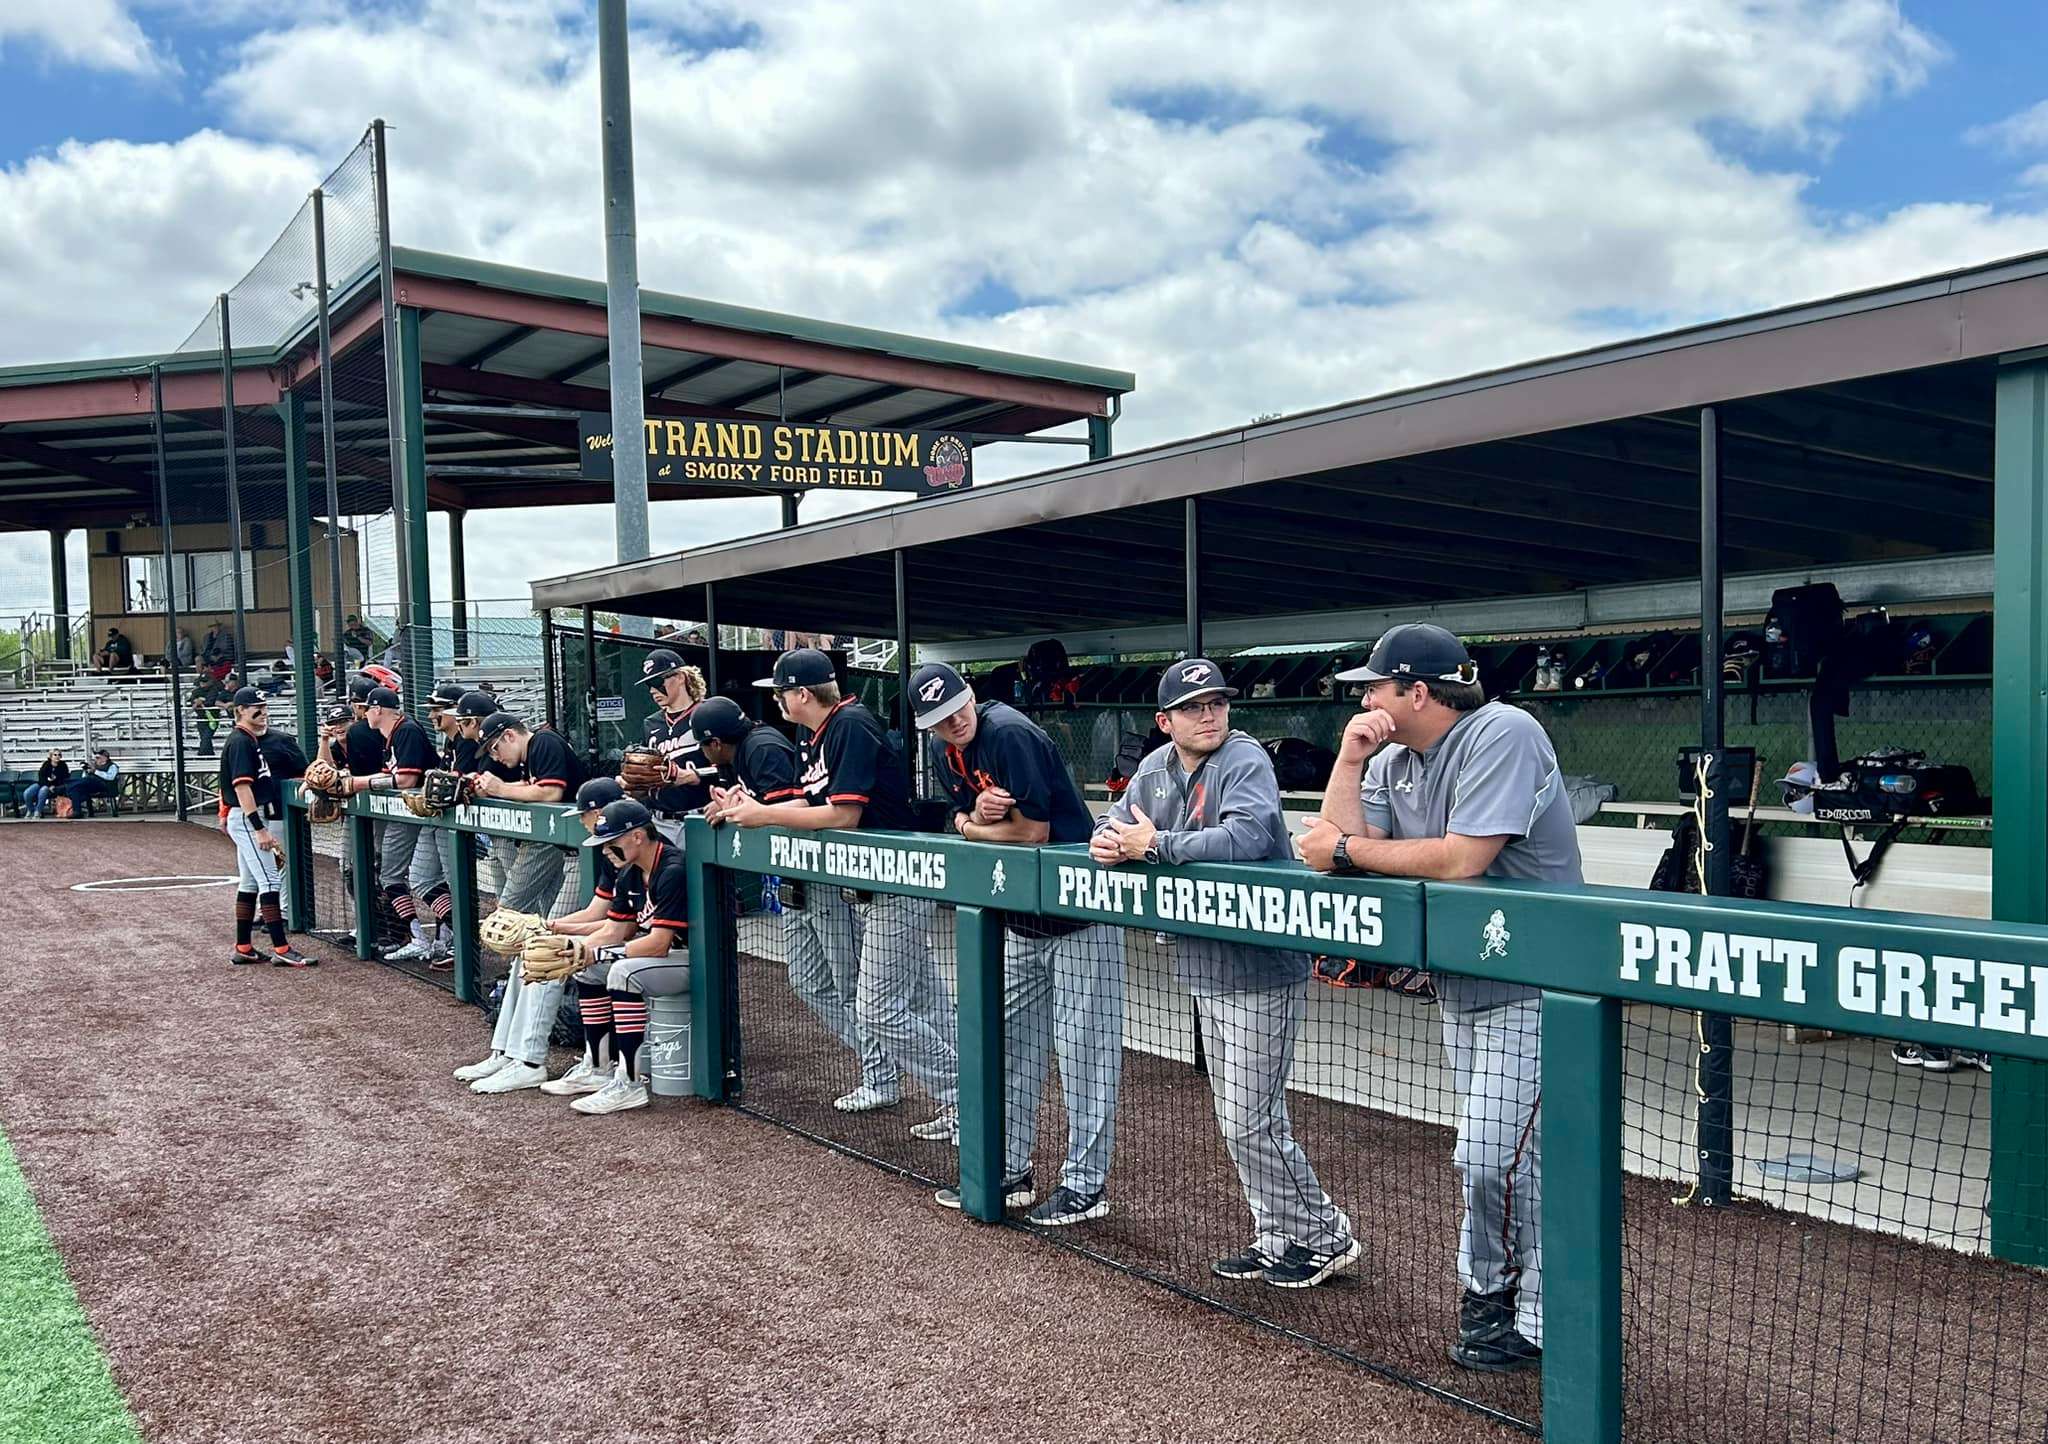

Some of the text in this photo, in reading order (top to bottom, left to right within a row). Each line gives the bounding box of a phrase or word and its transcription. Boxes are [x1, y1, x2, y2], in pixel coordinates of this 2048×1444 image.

[644, 419, 919, 467] TRAND STADIUM
[658, 461, 883, 486] at SMOKY FORD FIELD
[769, 835, 946, 889] PRATT GREENBACKS
[1058, 865, 1383, 947] PRATT GREENBACKS
[1620, 922, 1818, 1004] PRATT
